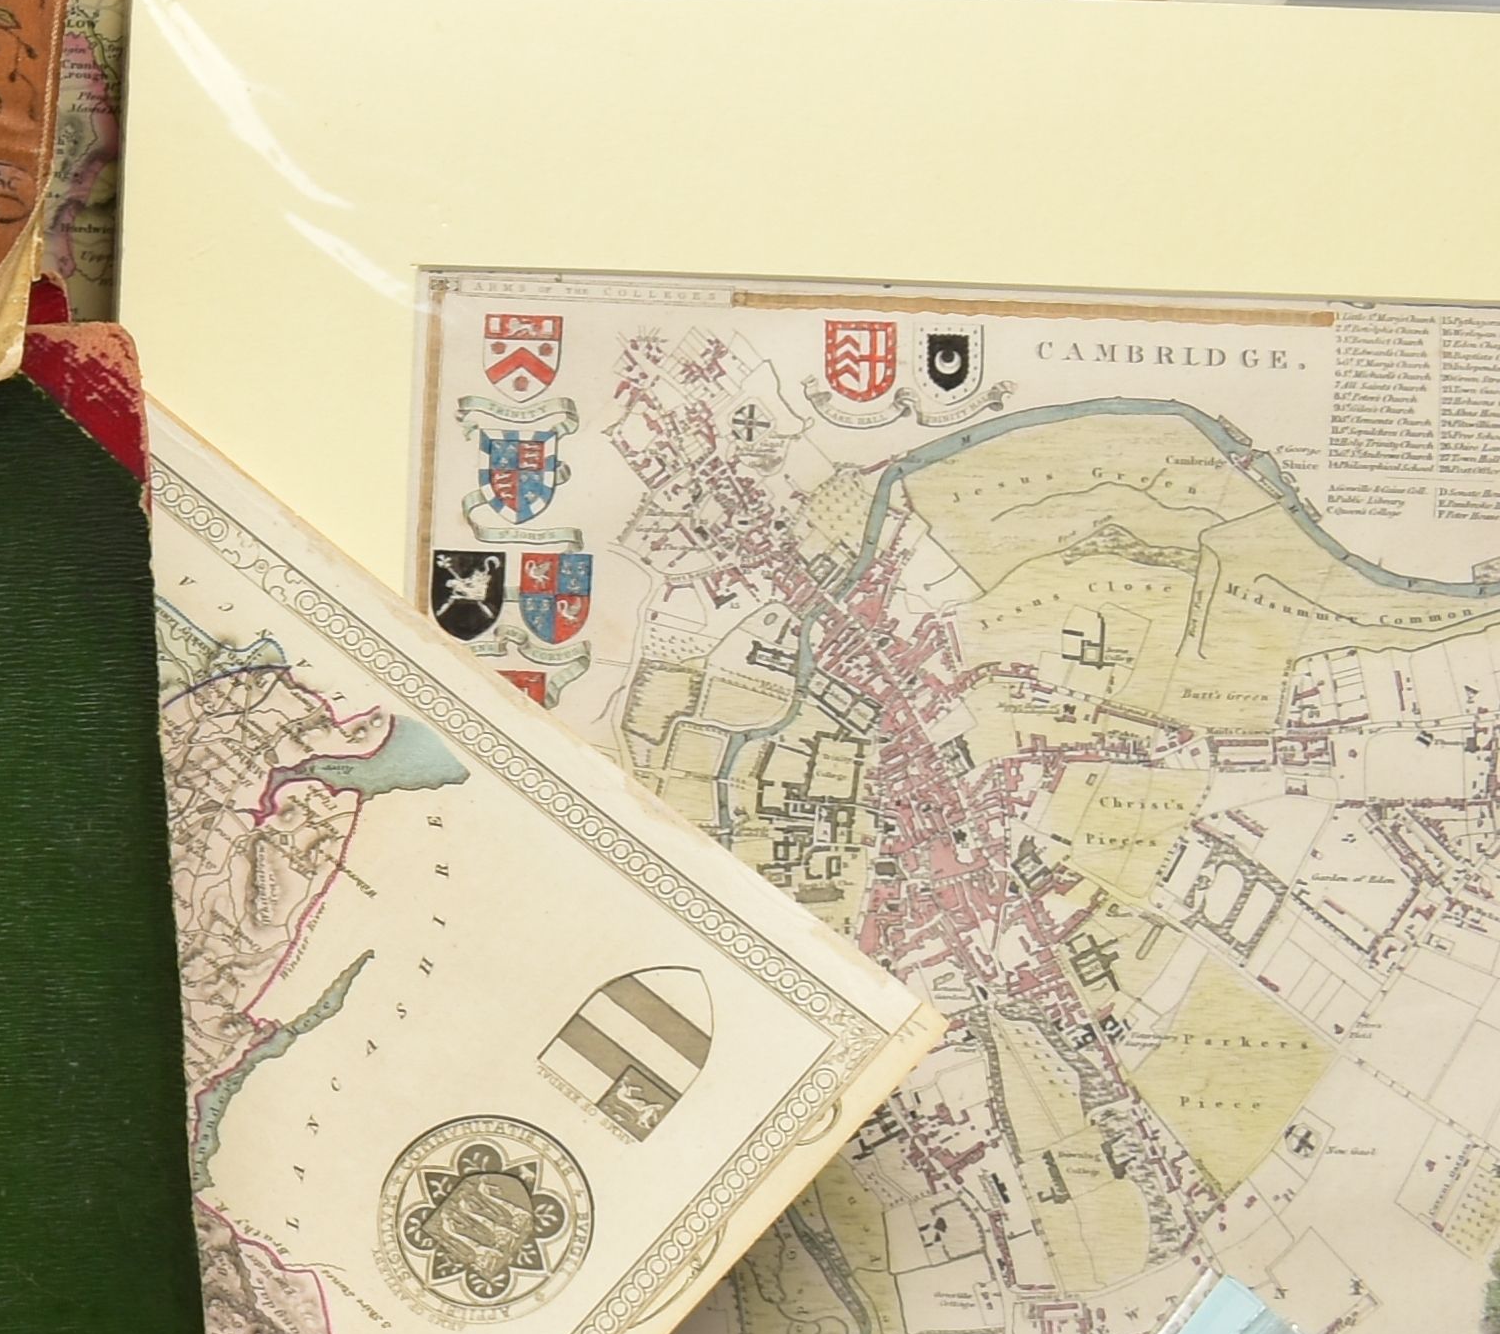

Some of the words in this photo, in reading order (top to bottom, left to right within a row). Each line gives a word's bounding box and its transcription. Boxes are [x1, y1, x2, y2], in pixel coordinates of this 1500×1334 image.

[1380, 608, 1473, 626] Common
[1086, 833, 1157, 847] Pieces
[1182, 1035, 1309, 1050] Parkers
[1179, 1096, 1261, 1110] Piece
